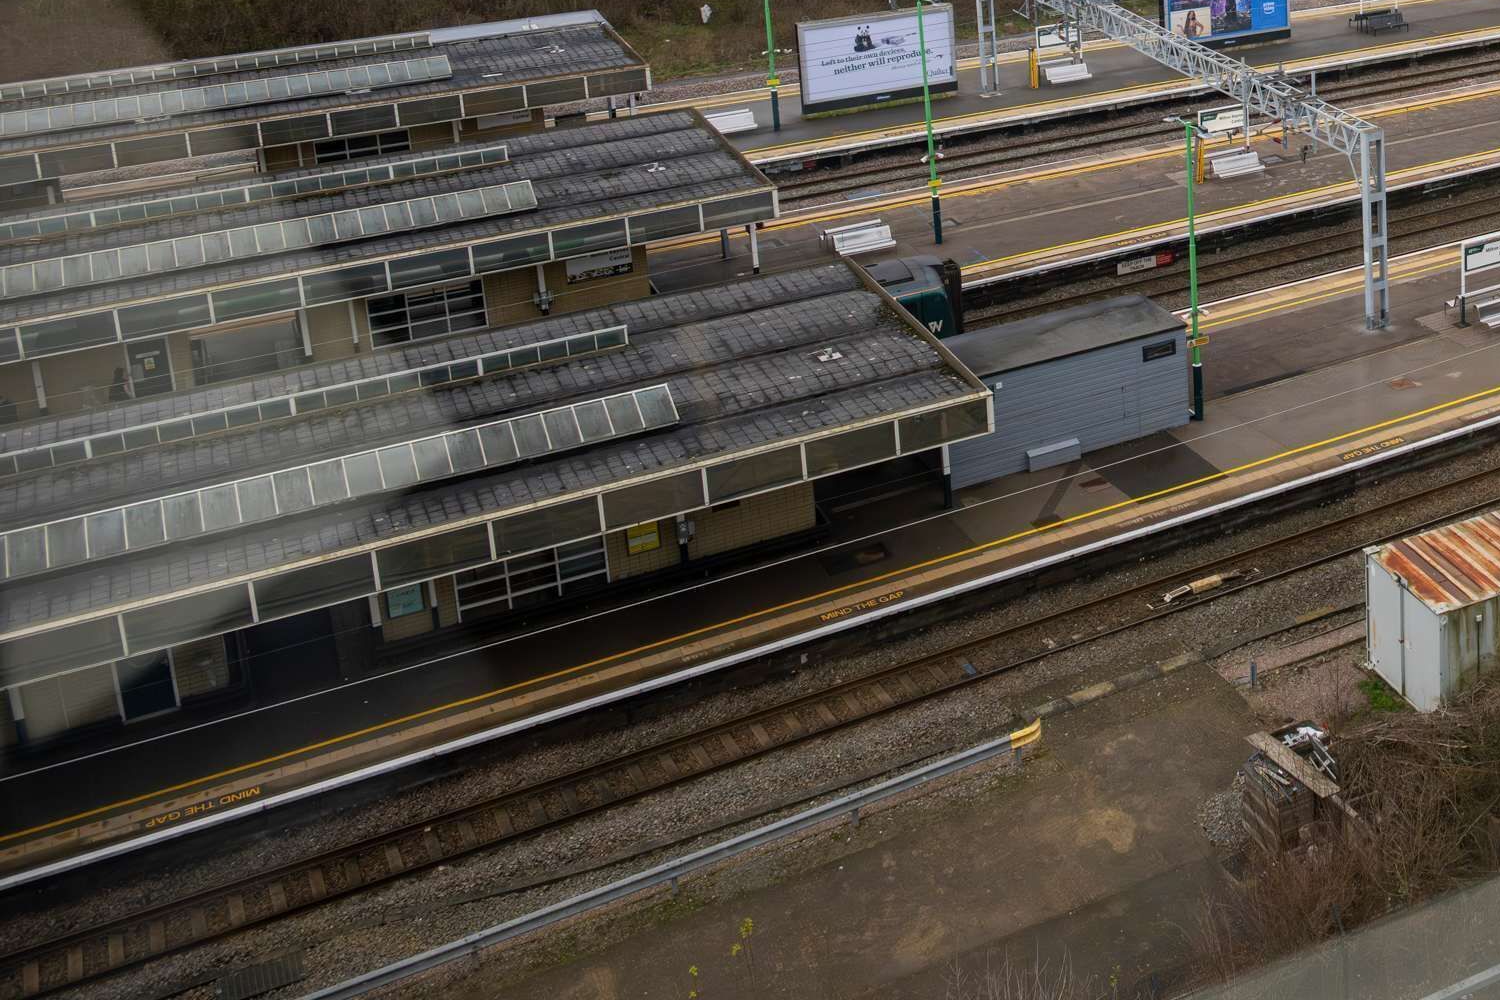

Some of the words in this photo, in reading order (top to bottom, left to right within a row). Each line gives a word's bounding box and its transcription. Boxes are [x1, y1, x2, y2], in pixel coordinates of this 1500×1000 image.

[821, 57, 837, 66] Left
[845, 54, 862, 63] their
[833, 62, 867, 75] neither
[868, 57, 886, 67] will
[887, 48, 934, 64] reprodue.
[820, 607, 853, 621] MIND
[855, 599, 878, 610] THE
[879, 591, 904, 603] GAP
[220, 785, 261, 804] MIND
[184, 800, 216, 816] THE
[145, 810, 181, 828] GAP
